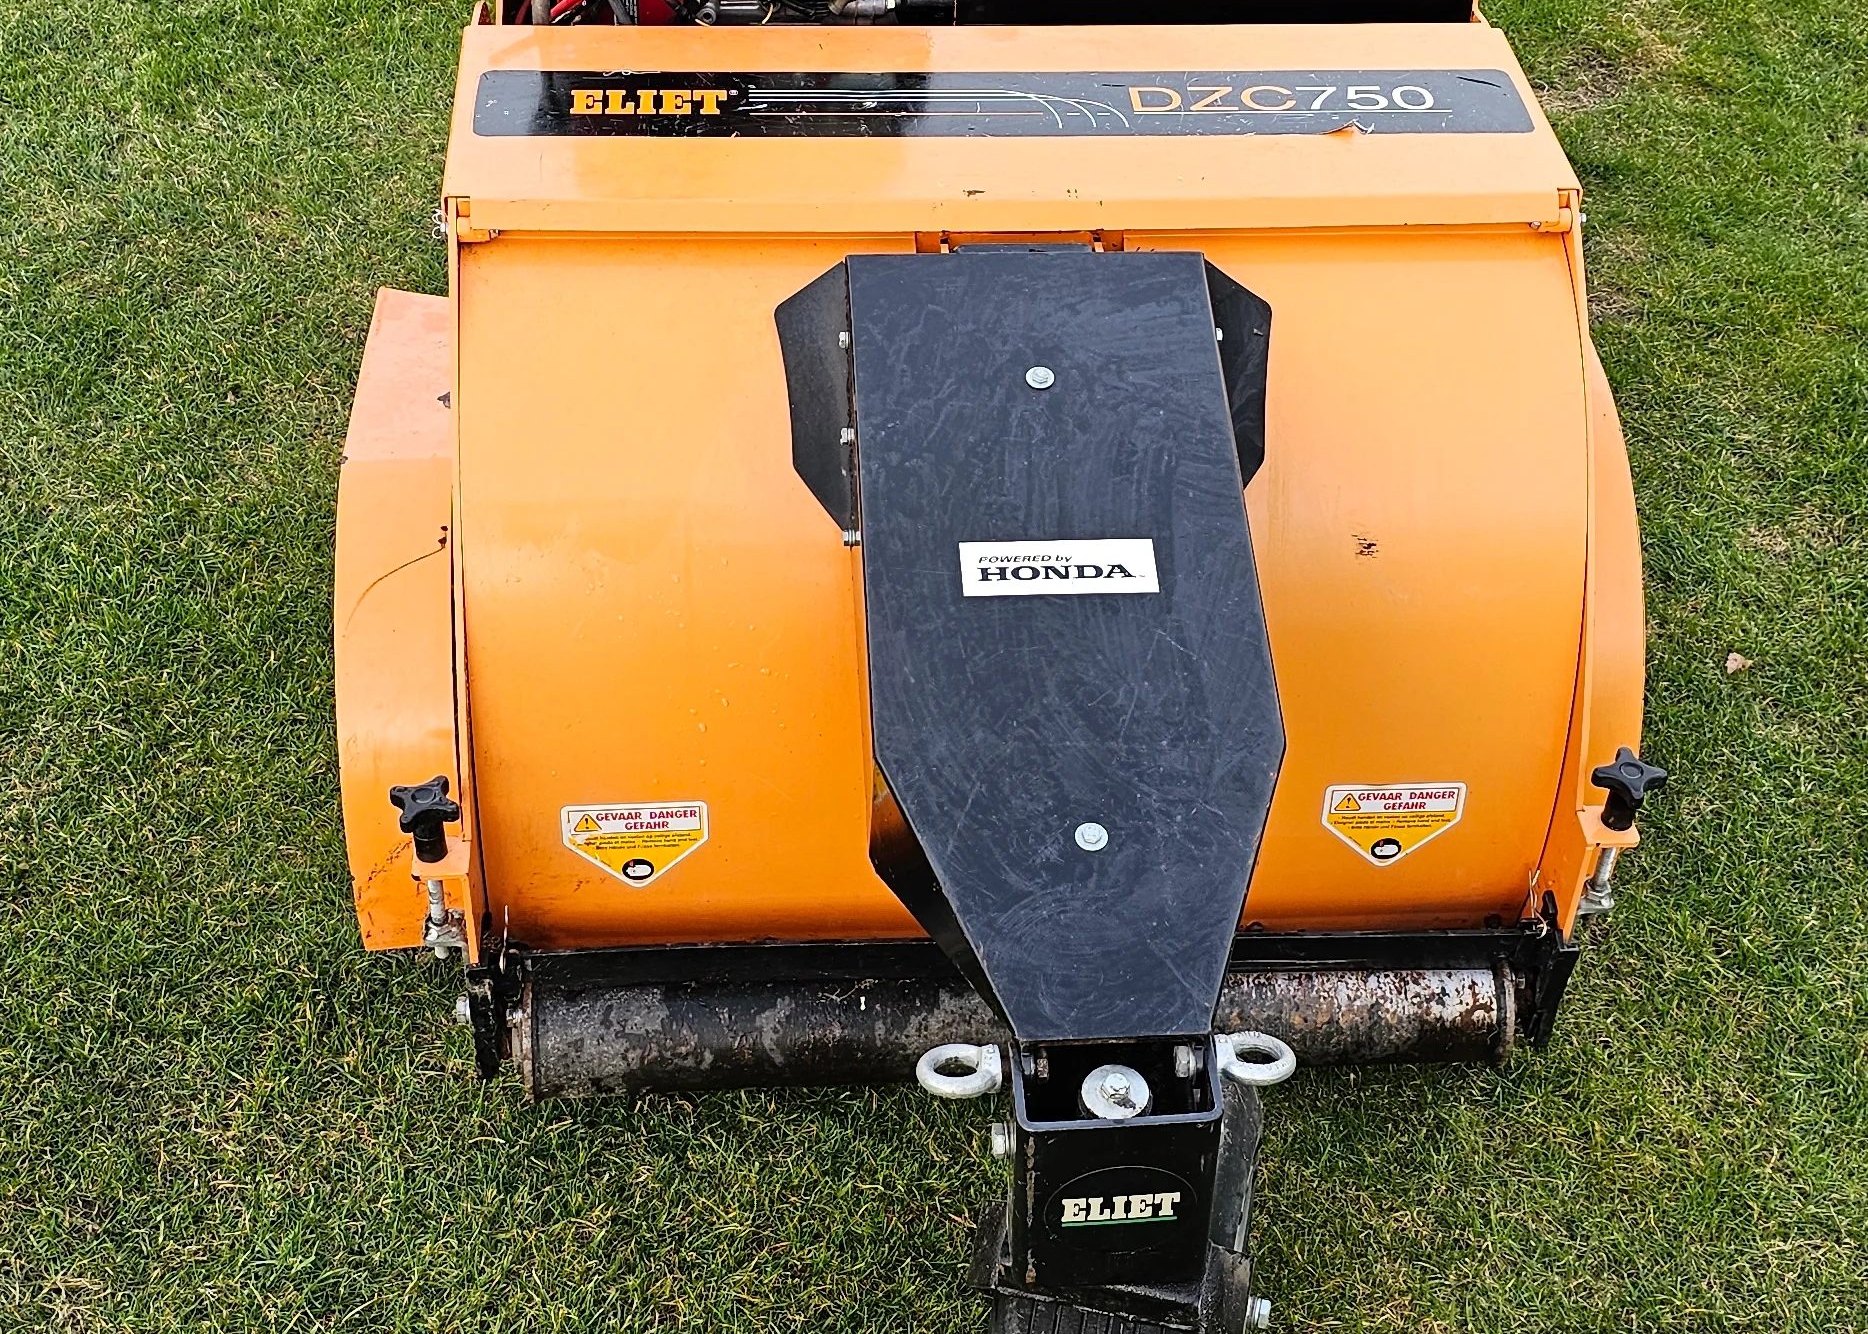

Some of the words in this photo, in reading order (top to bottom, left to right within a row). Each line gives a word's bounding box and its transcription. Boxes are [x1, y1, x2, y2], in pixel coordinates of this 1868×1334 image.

[570, 89, 728, 115] ELIET
[1128, 85, 1435, 112] DZC750
[978, 555, 1052, 564] POWERED
[1055, 554, 1073, 563] by
[976, 563, 1137, 582] HONDA
[1358, 792, 1403, 802] GEVAAR
[1409, 790, 1456, 800] DANGER
[1383, 801, 1427, 811] GEFAHR
[595, 811, 642, 821] GEVAAR
[649, 809, 698, 820] DANGER
[624, 820, 669, 831] GEFAHR
[1061, 1192, 1181, 1223] ELIET
